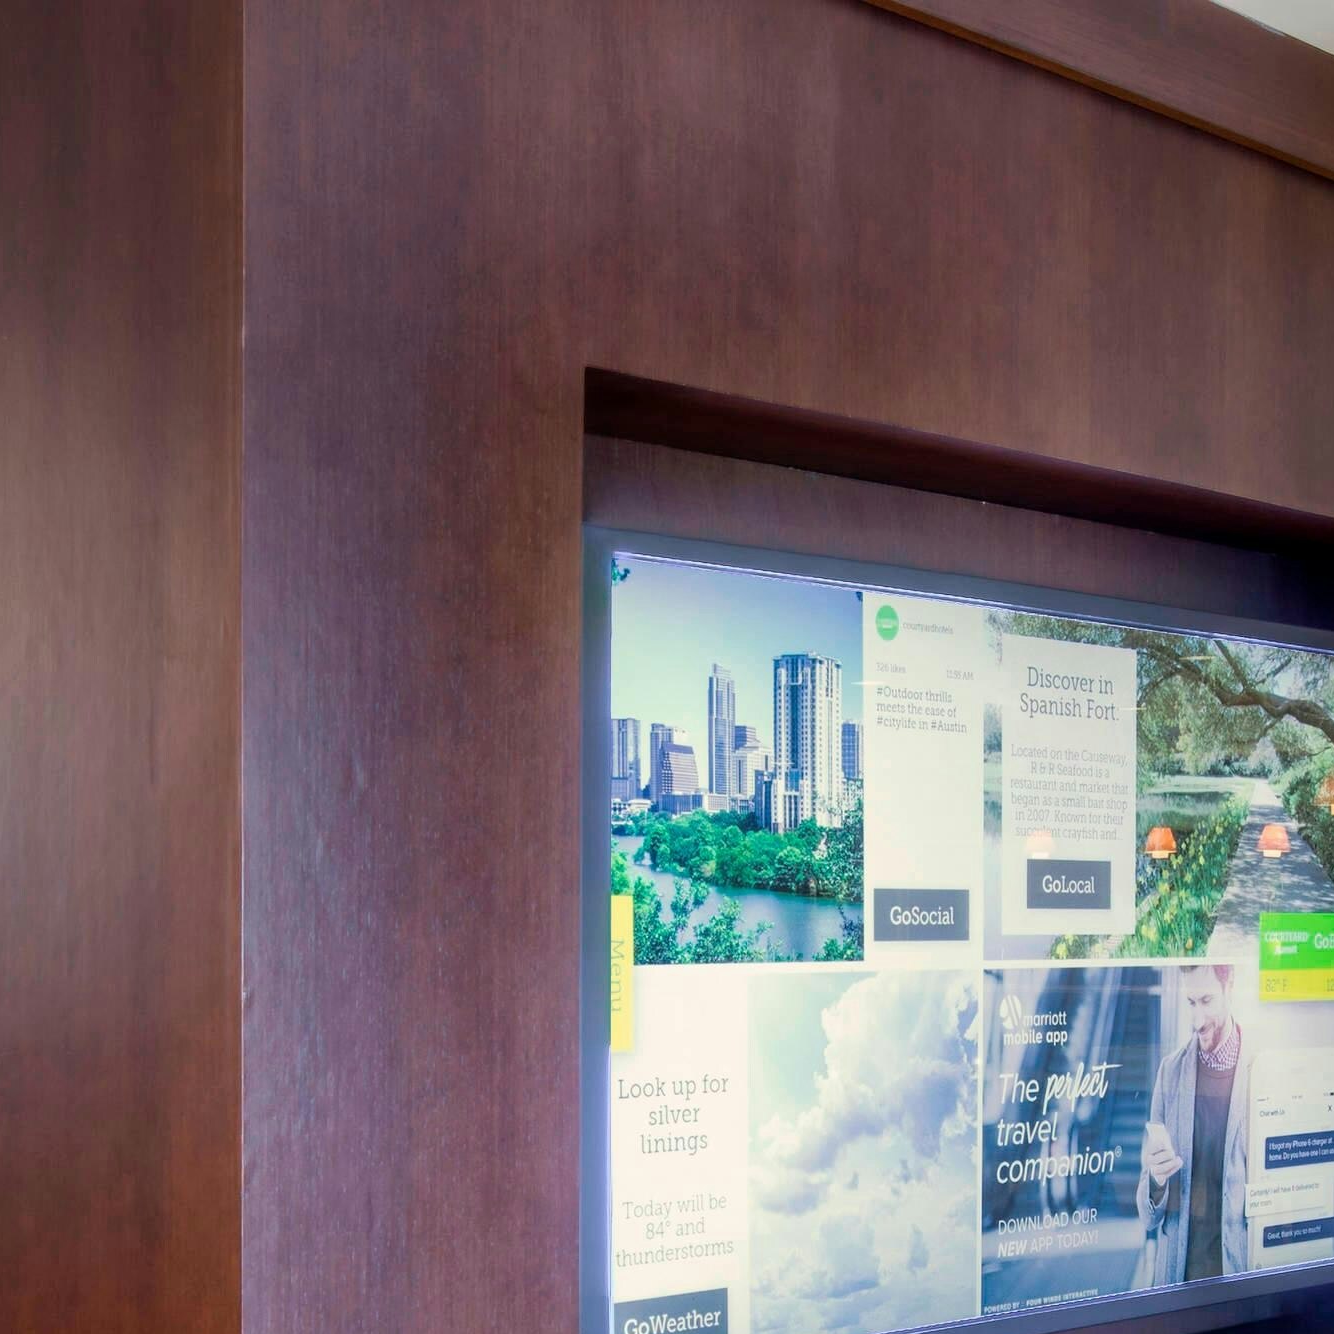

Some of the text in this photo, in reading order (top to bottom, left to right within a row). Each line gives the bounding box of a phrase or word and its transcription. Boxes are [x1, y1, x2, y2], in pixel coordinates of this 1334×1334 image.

[1027, 666, 1114, 695] Discover in
[876, 686, 952, 703] #Outdoor thrills
[876, 702, 957, 718] meets the ease of
[1020, 692, 1120, 721] Spanish Fort.
[876, 717, 967, 733] #citylife in #Austin
[1011, 743, 1048, 759] Located
[1050, 749, 1062, 760] on
[1065, 748, 1079, 761] the
[1031, 761, 1110, 778] R & R Seafood is a
[1010, 778, 1129, 795] restaurant and market that
[1011, 792, 1040, 808] began
[1042, 796, 1053, 807] as
[1054, 798, 1060, 807] a
[1062, 796, 1086, 808] small
[1106, 798, 1128, 813] shop
[1015, 808, 1025, 821] in
[1054, 810, 1086, 824] Known
[1089, 812, 1101, 825] for
[1103, 813, 1123, 825] their
[1062, 827, 1098, 842] crayfish
[1042, 874, 1095, 895] GoLocal
[890, 905, 955, 926] GoSocial
[611, 939, 625, 1012] Menu
[1024, 1011, 1067, 1027] marriott
[1003, 1030, 1068, 1046] mobile app
[618, 1074, 729, 1101] Look up for
[999, 1061, 1124, 1115] The perfect
[648, 1104, 700, 1126] silver
[997, 1112, 1058, 1147] travel
[640, 1133, 709, 1156] linings
[622, 1193, 727, 1219] Today will be
[645, 1216, 706, 1240] 84° and
[998, 1208, 1098, 1236] DOWNLOAD OUR
[616, 1240, 734, 1268] thunderstorms
[997, 1230, 1099, 1258] NEW APP TODAY!
[983, 1288, 1098, 1314] POWERED BY FOUR WINDS INTERACTIVE
